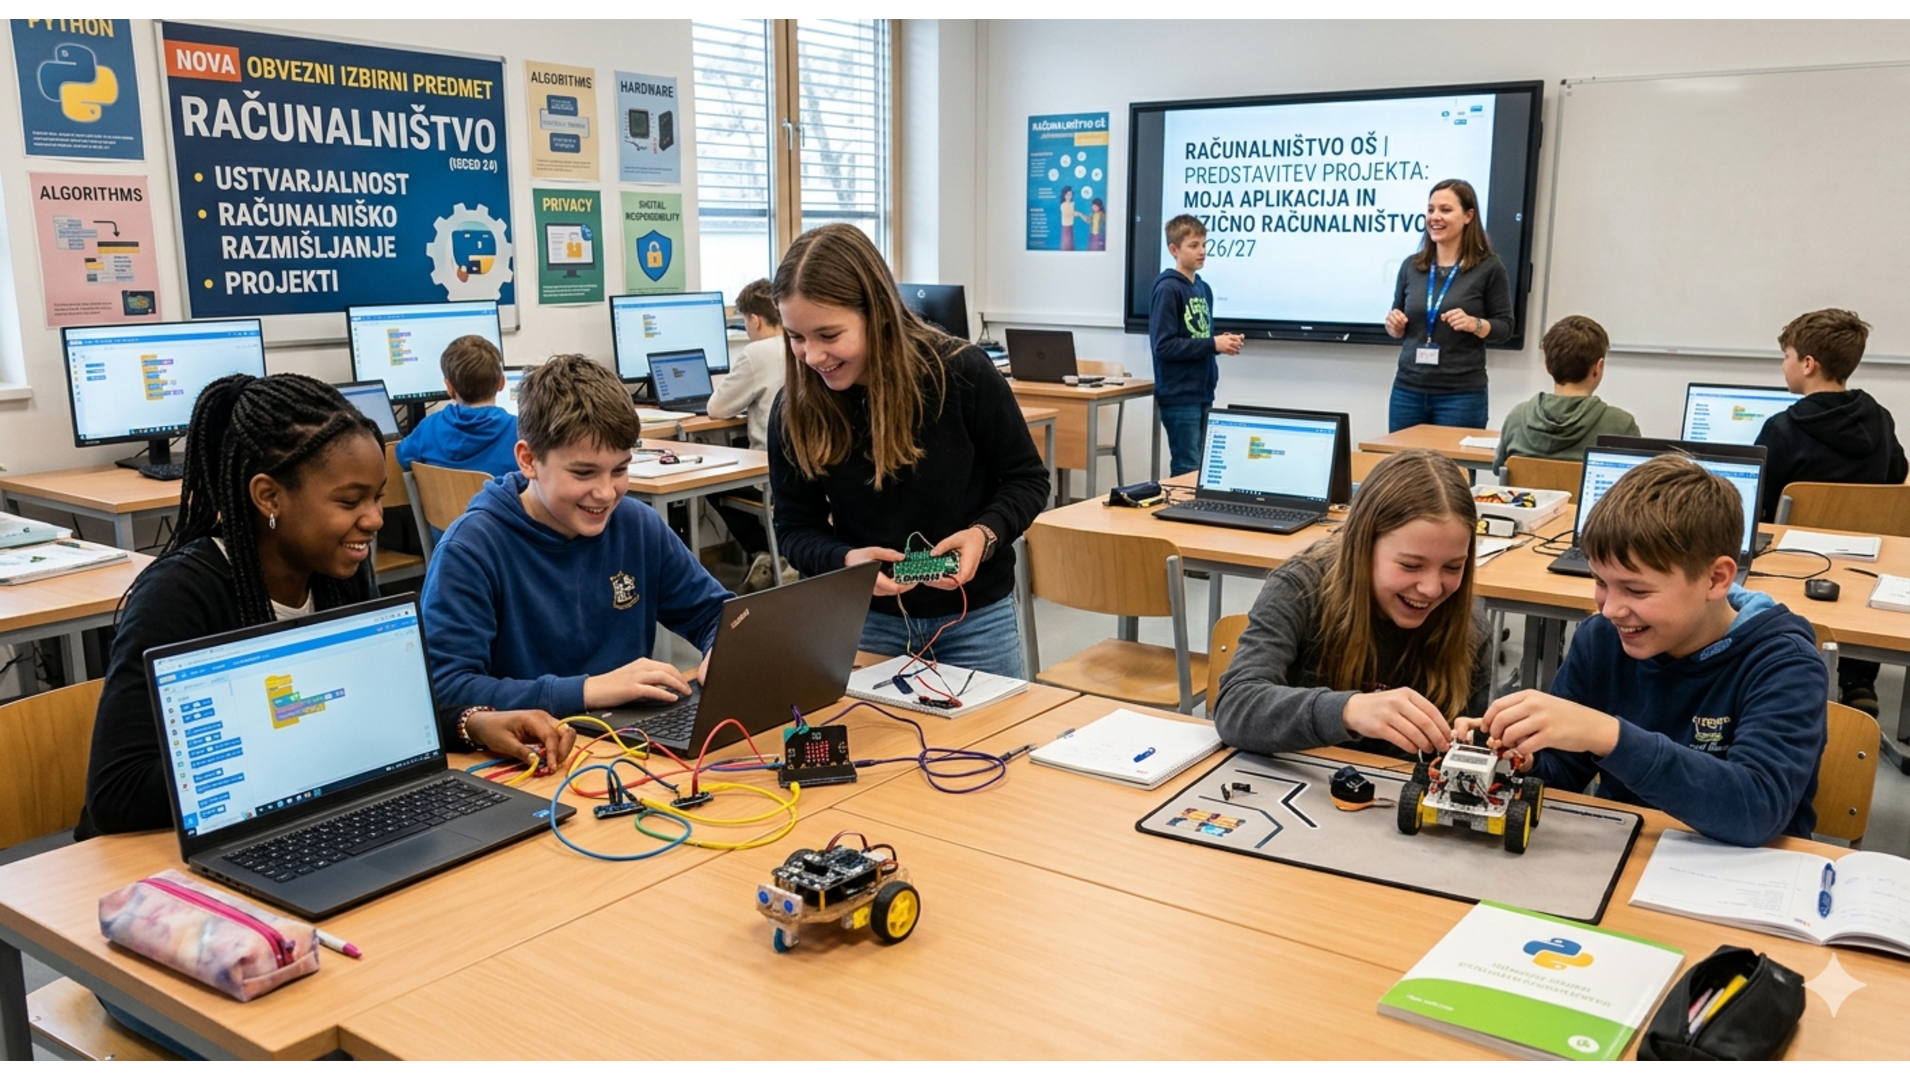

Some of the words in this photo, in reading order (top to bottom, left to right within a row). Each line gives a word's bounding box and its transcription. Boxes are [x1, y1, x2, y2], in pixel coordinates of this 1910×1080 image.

[176, 48, 236, 75] NOVA
[247, 56, 335, 86] OBVEZNI
[341, 65, 408, 92] IZBIRNI
[413, 74, 493, 99] PREDMET
[181, 89, 496, 154] RAČUNALNIŠTVO
[1185, 133, 1344, 160] RAČUNALNIŠTVO
[1350, 131, 1377, 155] OŠ
[215, 165, 409, 195] USTVARJALNOST
[1185, 163, 1317, 184] PREDSTAVITEV
[1322, 161, 1429, 182] PROJEKTA:
[40, 186, 143, 202] ALGORITHMS
[542, 197, 593, 213] PRIVACY
[1184, 190, 1234, 208] MOJA
[1240, 189, 1350, 208] APLIKACIJA
[1356, 189, 1376, 207] IN
[218, 196, 398, 228] RAČUNALNIŠKO
[1195, 210, 1256, 232] ZIČNO
[1262, 209, 1427, 233] RAČUNALNIŠTVO
[221, 230, 397, 259] RAZMIŠLJANJE
[1205, 239, 1257, 257] 26/27
[224, 269, 339, 295] PROJEKTI
